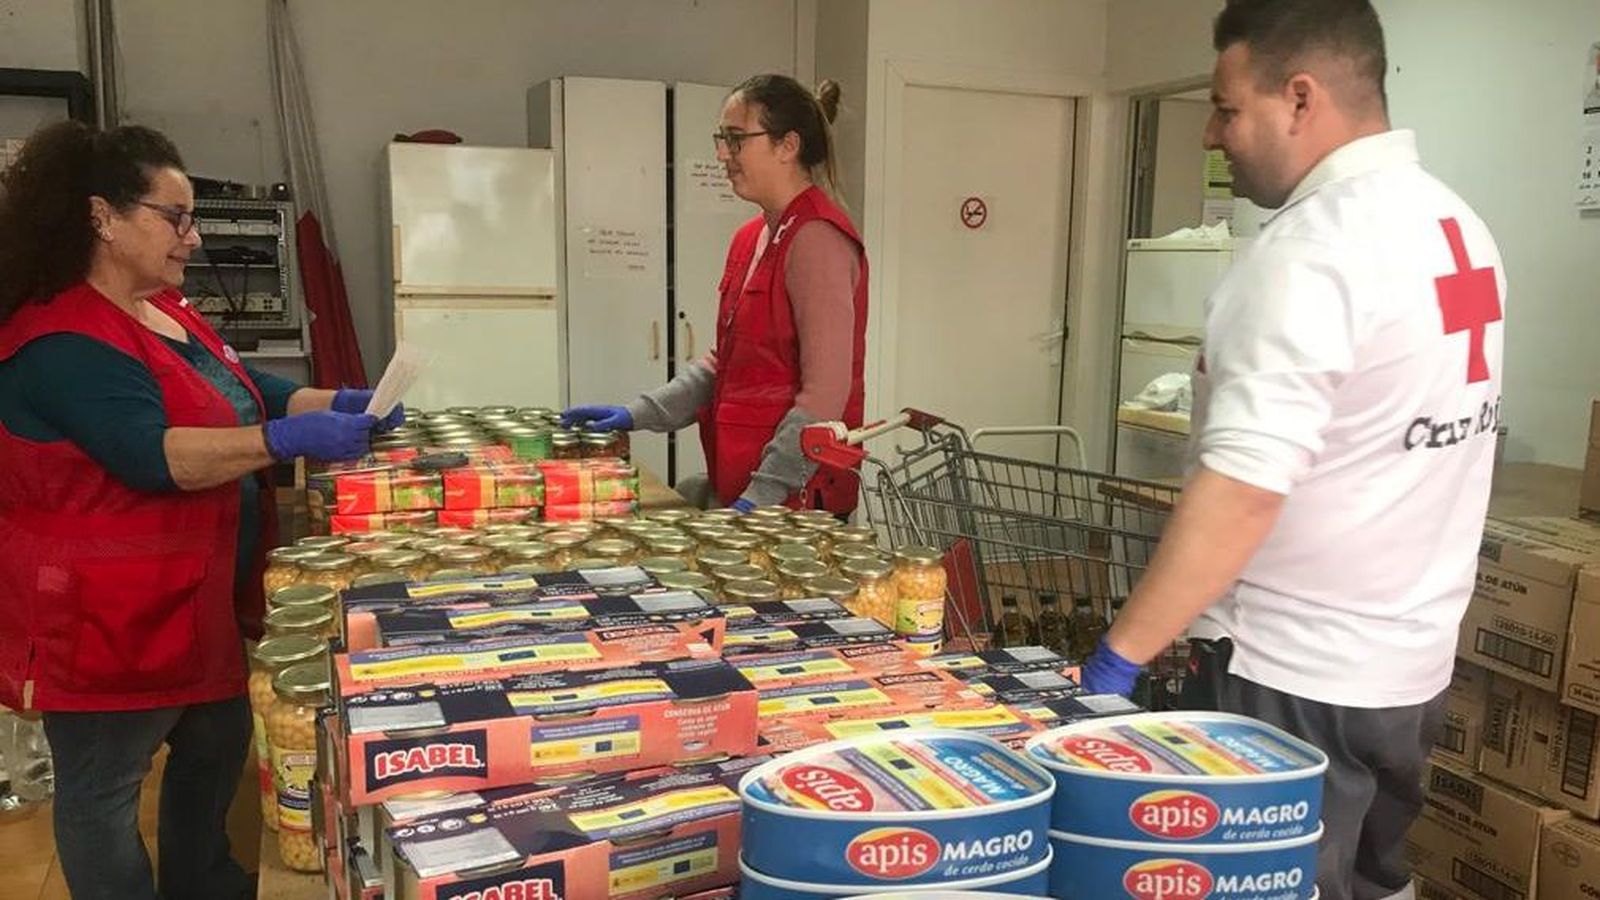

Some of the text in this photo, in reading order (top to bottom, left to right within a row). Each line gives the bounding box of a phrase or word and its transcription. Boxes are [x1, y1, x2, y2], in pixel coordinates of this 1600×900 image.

[375, 743, 480, 780] ISABEL
[1075, 740, 1142, 773] apis
[795, 769, 863, 811] apis
[943, 756, 1007, 795] MAGRO
[1142, 799, 1309, 833] apis MAGRO
[1222, 828, 1238, 840] de
[860, 829, 1034, 875] apis MAGRO
[943, 864, 960, 877] de
[962, 861, 994, 876] cerdo
[1135, 867, 1303, 900] apis MAGRO
